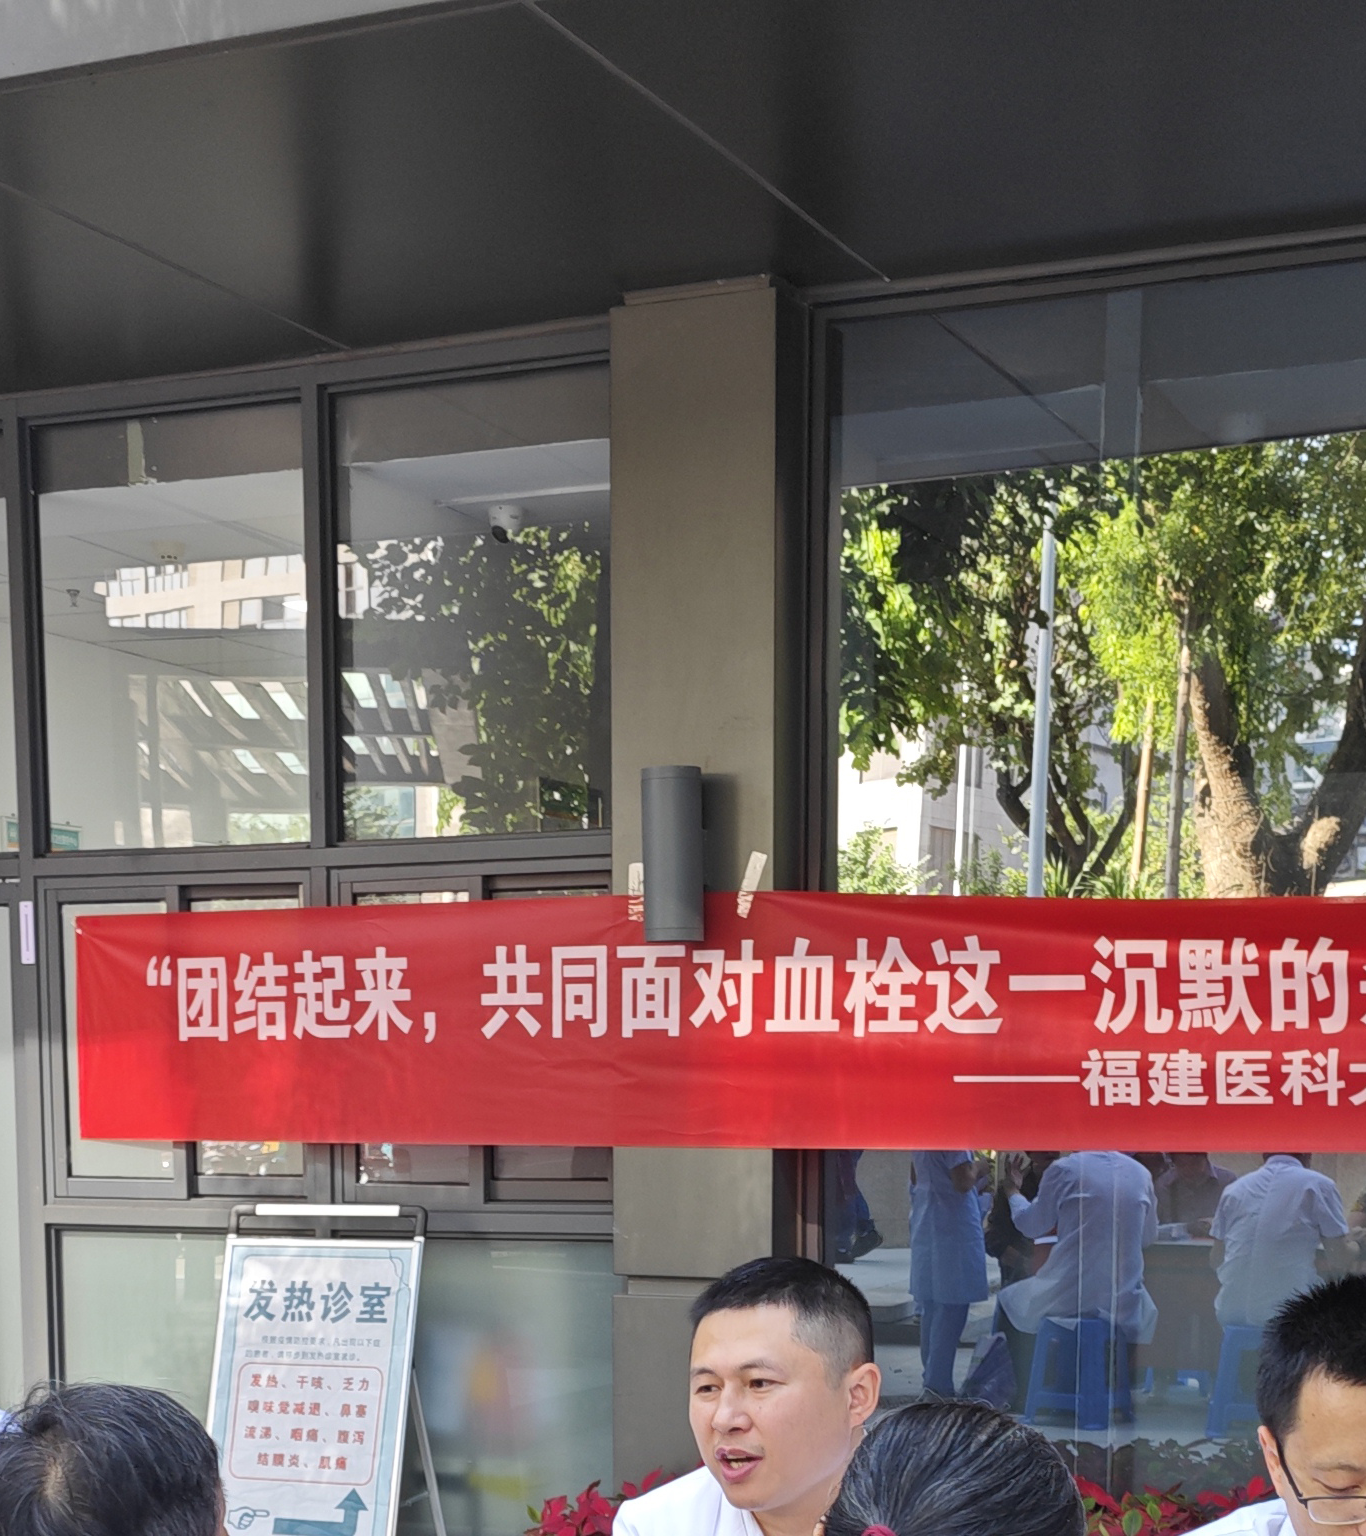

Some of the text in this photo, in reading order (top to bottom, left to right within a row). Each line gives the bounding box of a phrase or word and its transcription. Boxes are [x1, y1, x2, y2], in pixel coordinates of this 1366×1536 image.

[242, 1279, 393, 1324] 发热诊室
[250, 1373, 370, 1392] 发热、干咳、乏力
